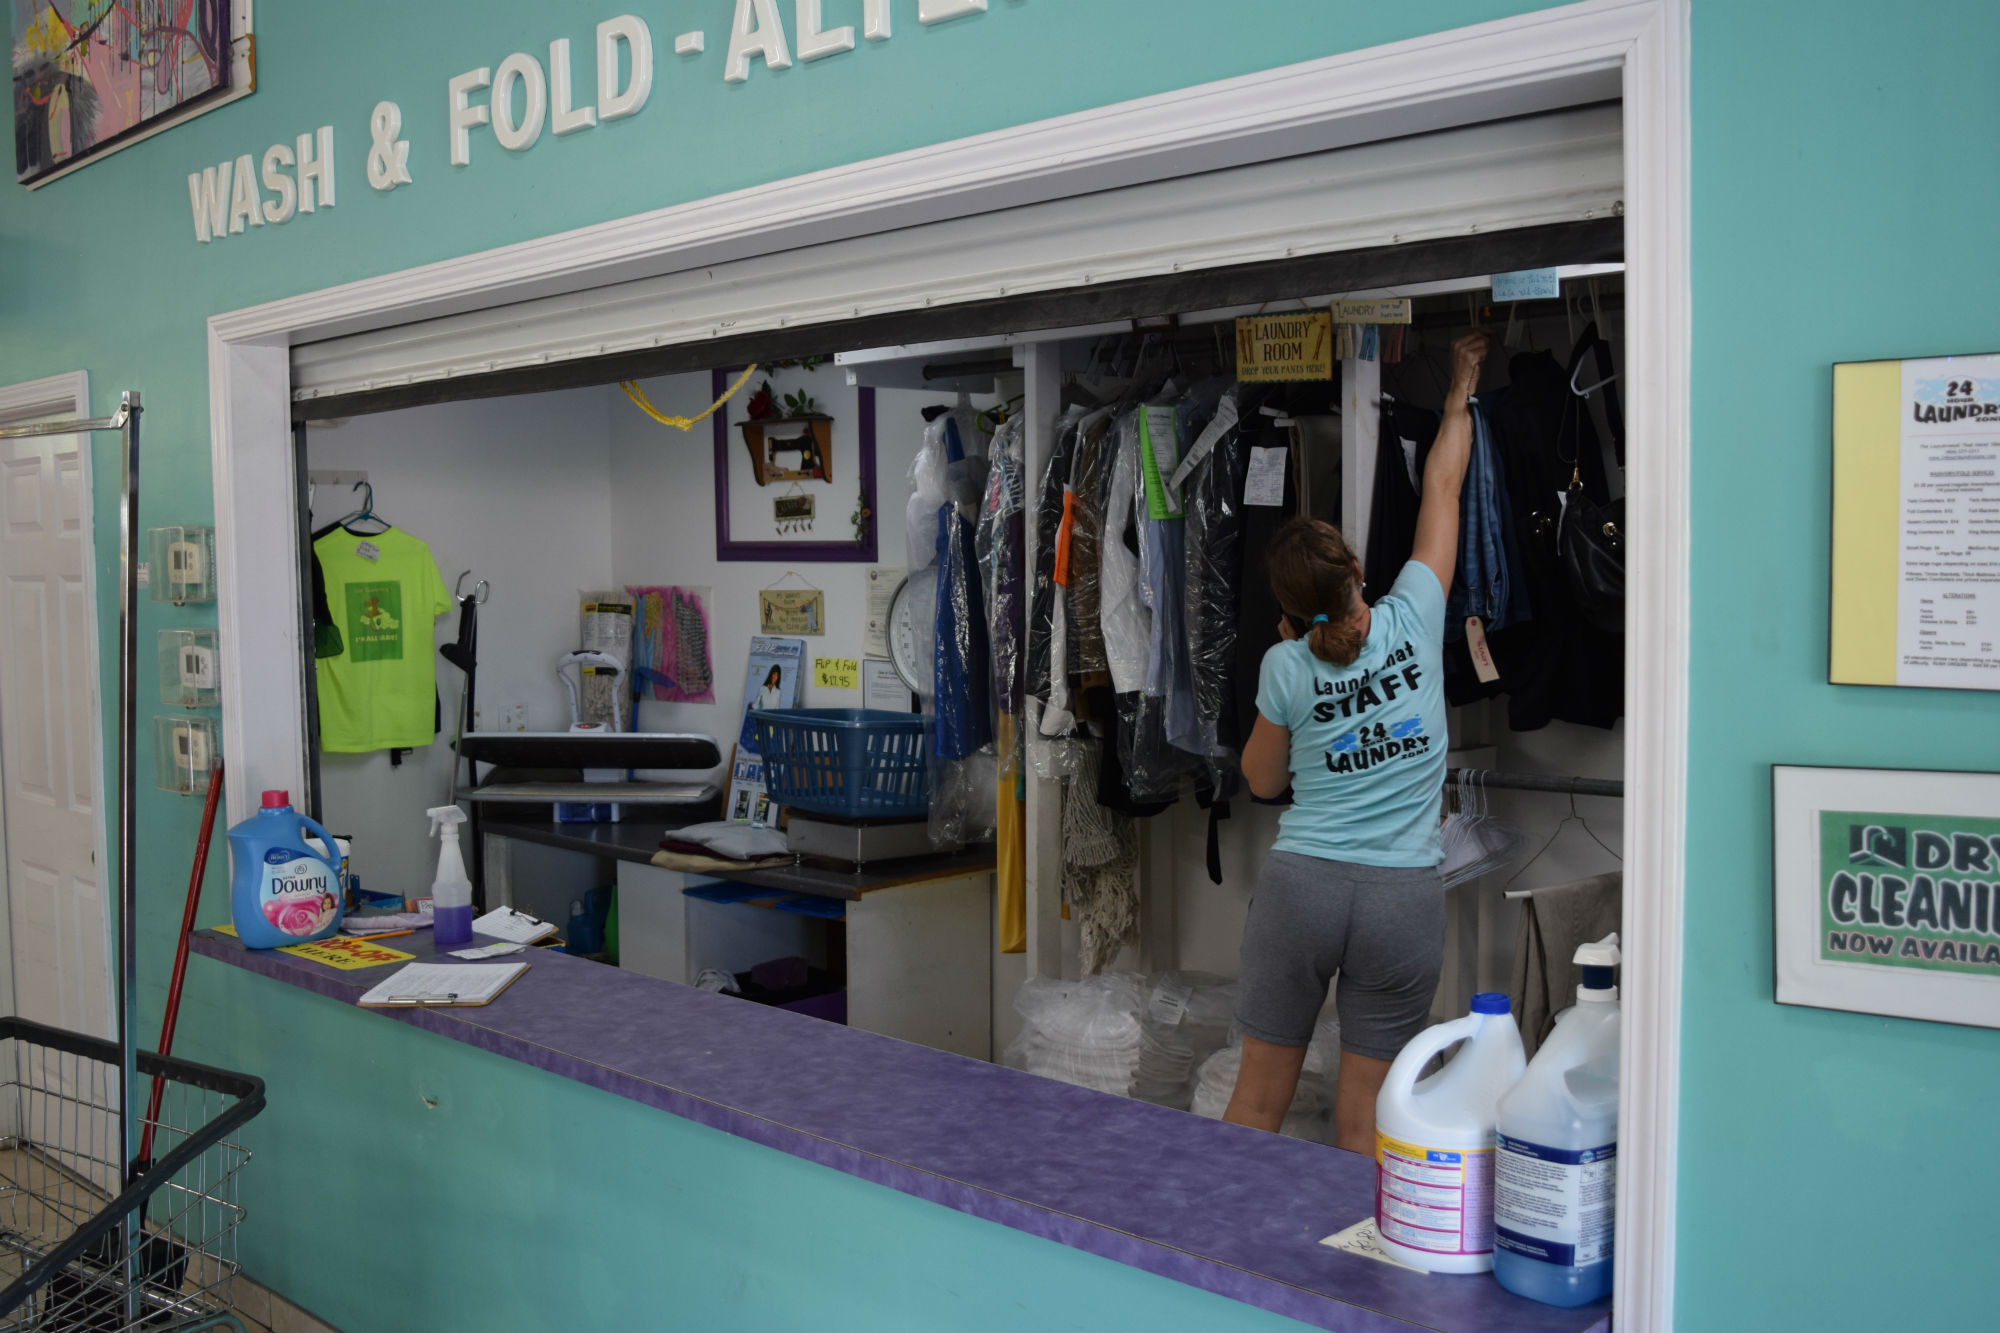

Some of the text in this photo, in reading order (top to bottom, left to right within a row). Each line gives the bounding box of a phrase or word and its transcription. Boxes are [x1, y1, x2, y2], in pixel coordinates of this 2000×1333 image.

[188, 125, 335, 243] WASH
[367, 100, 413, 191] &
[1255, 321, 1311, 341] LAUNDRY
[1263, 342, 1303, 362] ROOM
[1281, 364, 1304, 374] PANTS
[1946, 380, 1974, 397] 24
[1914, 401, 2000, 424] LAUNDR
[1313, 663, 1422, 723] STAFF
[1360, 722, 1387, 744] 24
[1324, 735, 1430, 774] LAUNDRY
[1401, 747, 1430, 760] ZONE
[271, 876, 328, 895] Downy
[1829, 870, 2000, 937] CLEANI
[1828, 931, 1894, 956] NOW
[1900, 936, 2000, 966] AVAILA
